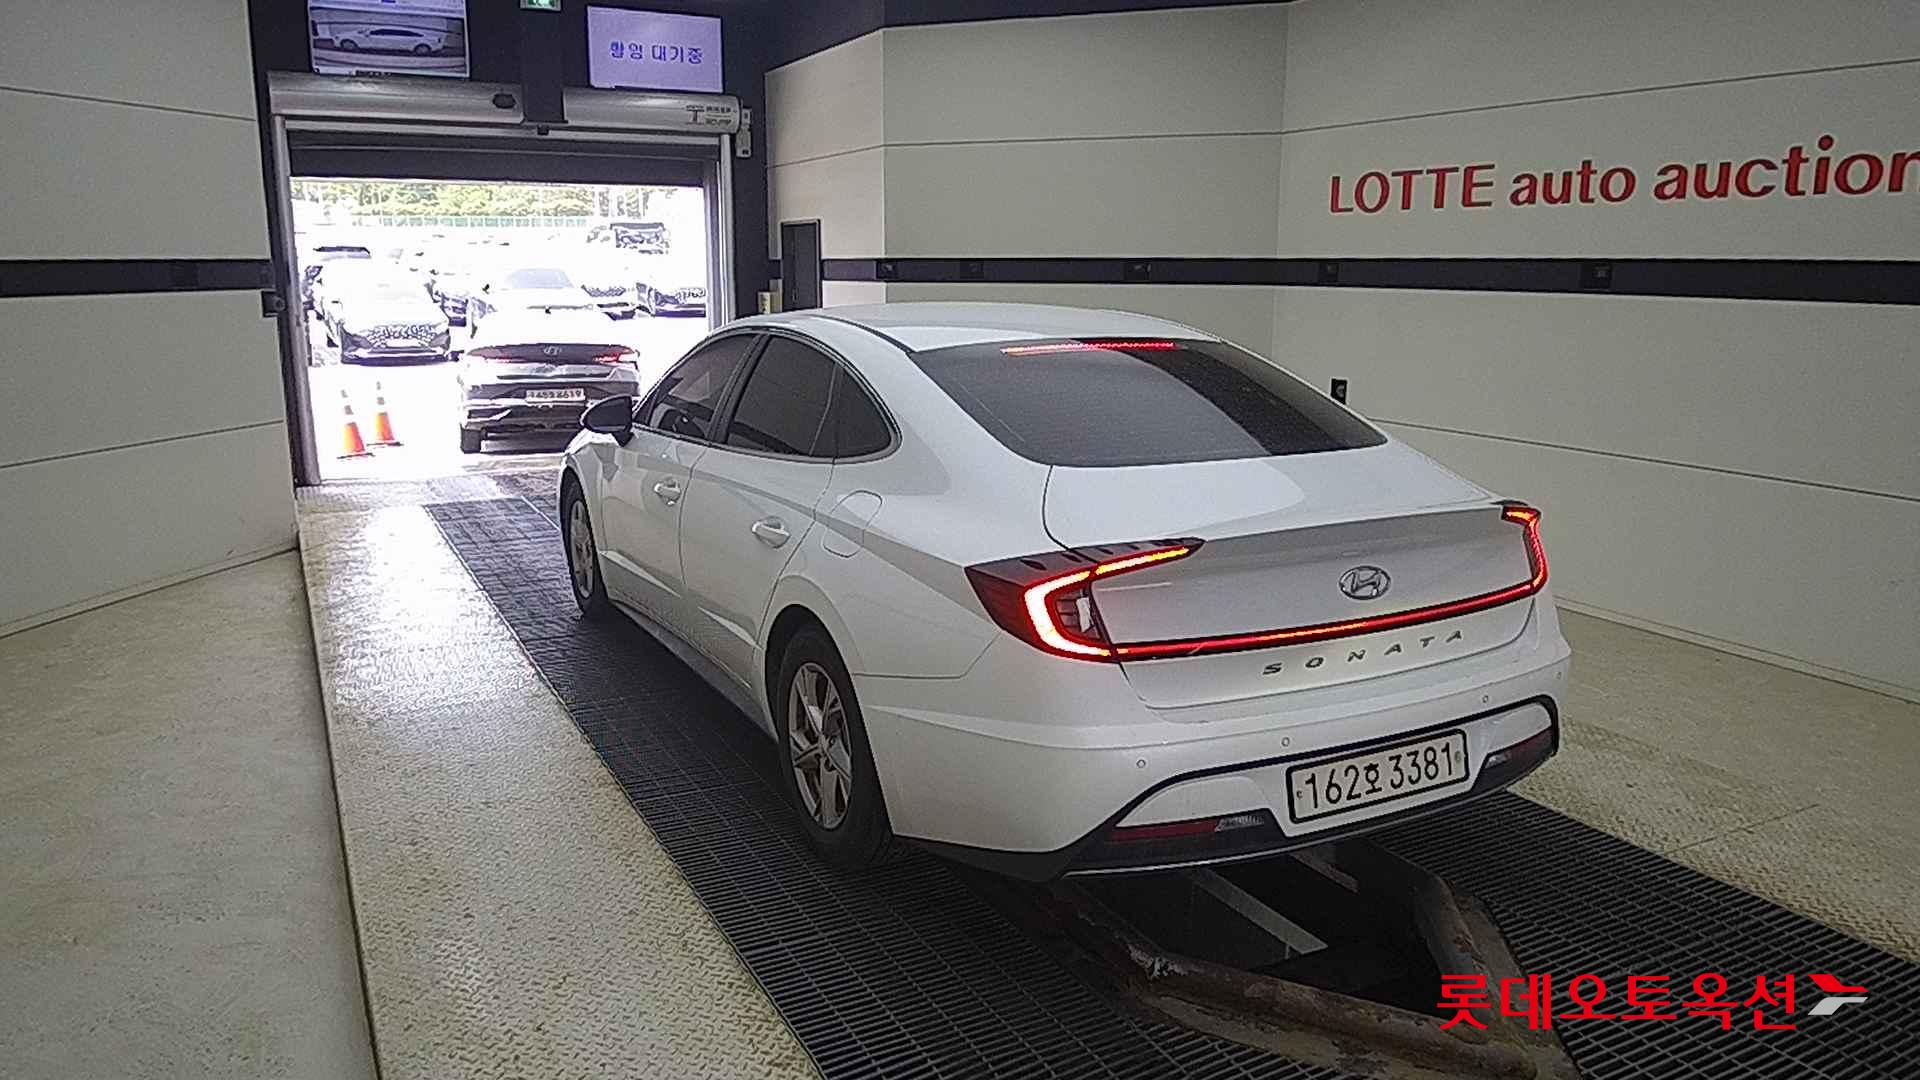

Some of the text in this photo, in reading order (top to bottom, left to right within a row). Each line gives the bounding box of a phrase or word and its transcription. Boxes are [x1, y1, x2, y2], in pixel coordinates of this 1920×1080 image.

[651, 44, 703, 65] 대기중
[1330, 163, 1495, 214] LOTTE
[1510, 159, 1637, 206] auto
[1262, 630, 1463, 675] SONATA
[1388, 742, 1454, 790] 3381
